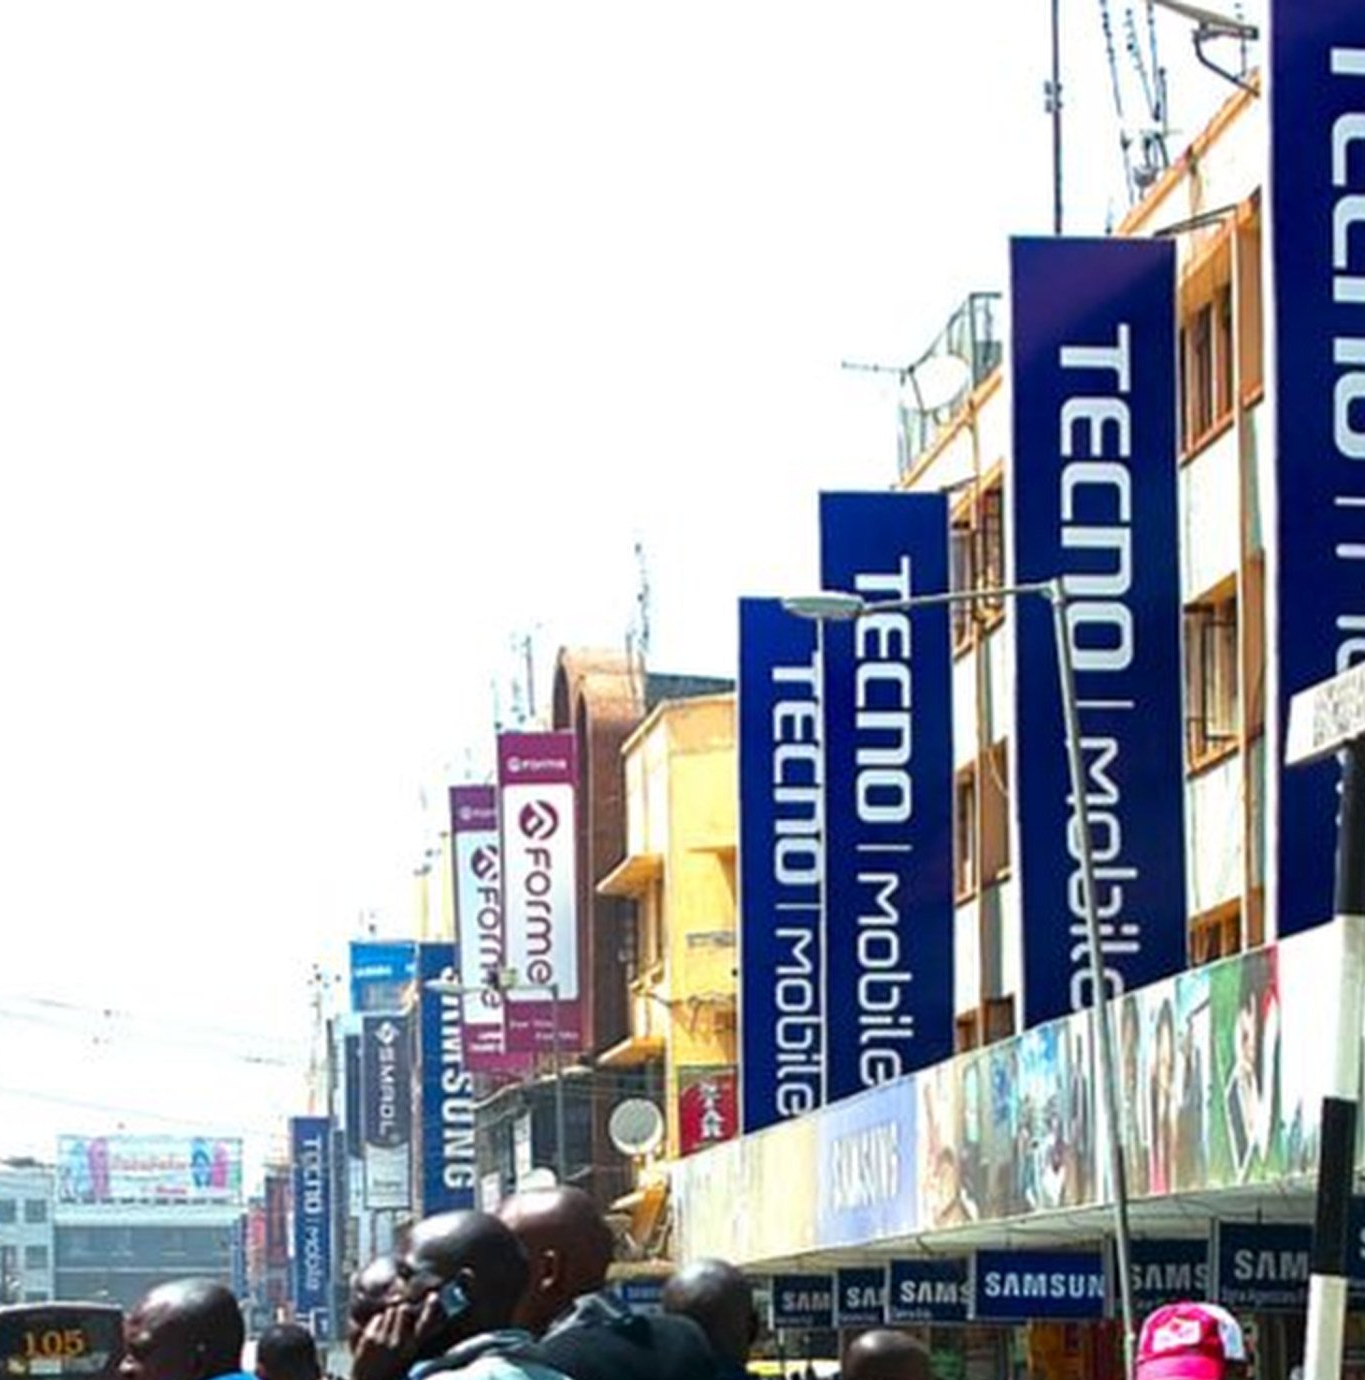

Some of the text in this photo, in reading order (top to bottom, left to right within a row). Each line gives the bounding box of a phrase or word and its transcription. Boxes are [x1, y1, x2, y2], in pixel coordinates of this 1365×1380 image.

[772, 652, 825, 1118] TECNO Mobile
[855, 555, 914, 1085] TECNO Mobile
[1060, 323, 1141, 1012] TECNO Mobile
